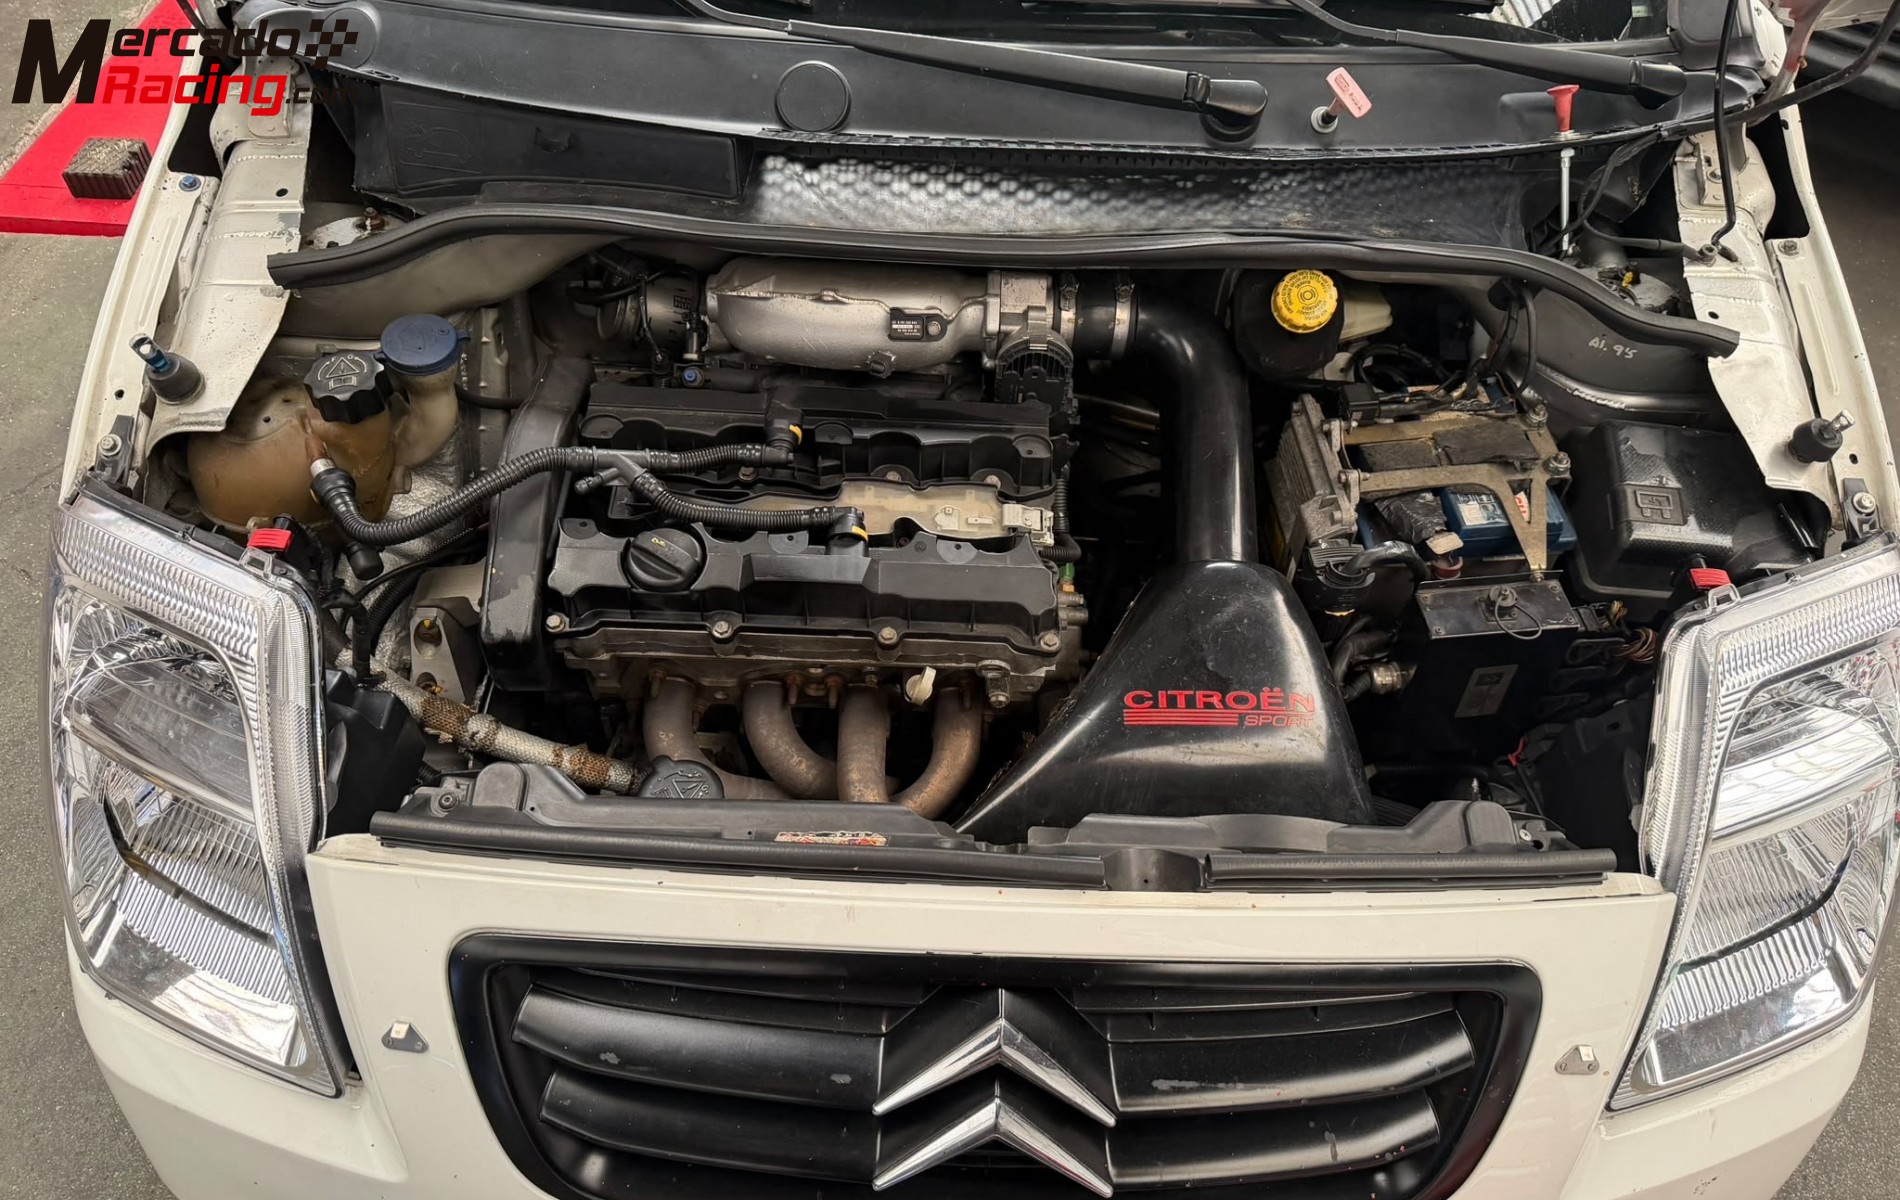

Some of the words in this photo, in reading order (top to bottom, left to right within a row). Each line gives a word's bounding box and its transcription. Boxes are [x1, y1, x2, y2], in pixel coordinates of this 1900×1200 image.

[1613, 344, 1637, 359] 95
[1123, 687, 1315, 712] CITROËN
[1244, 714, 1313, 728] SPORT
